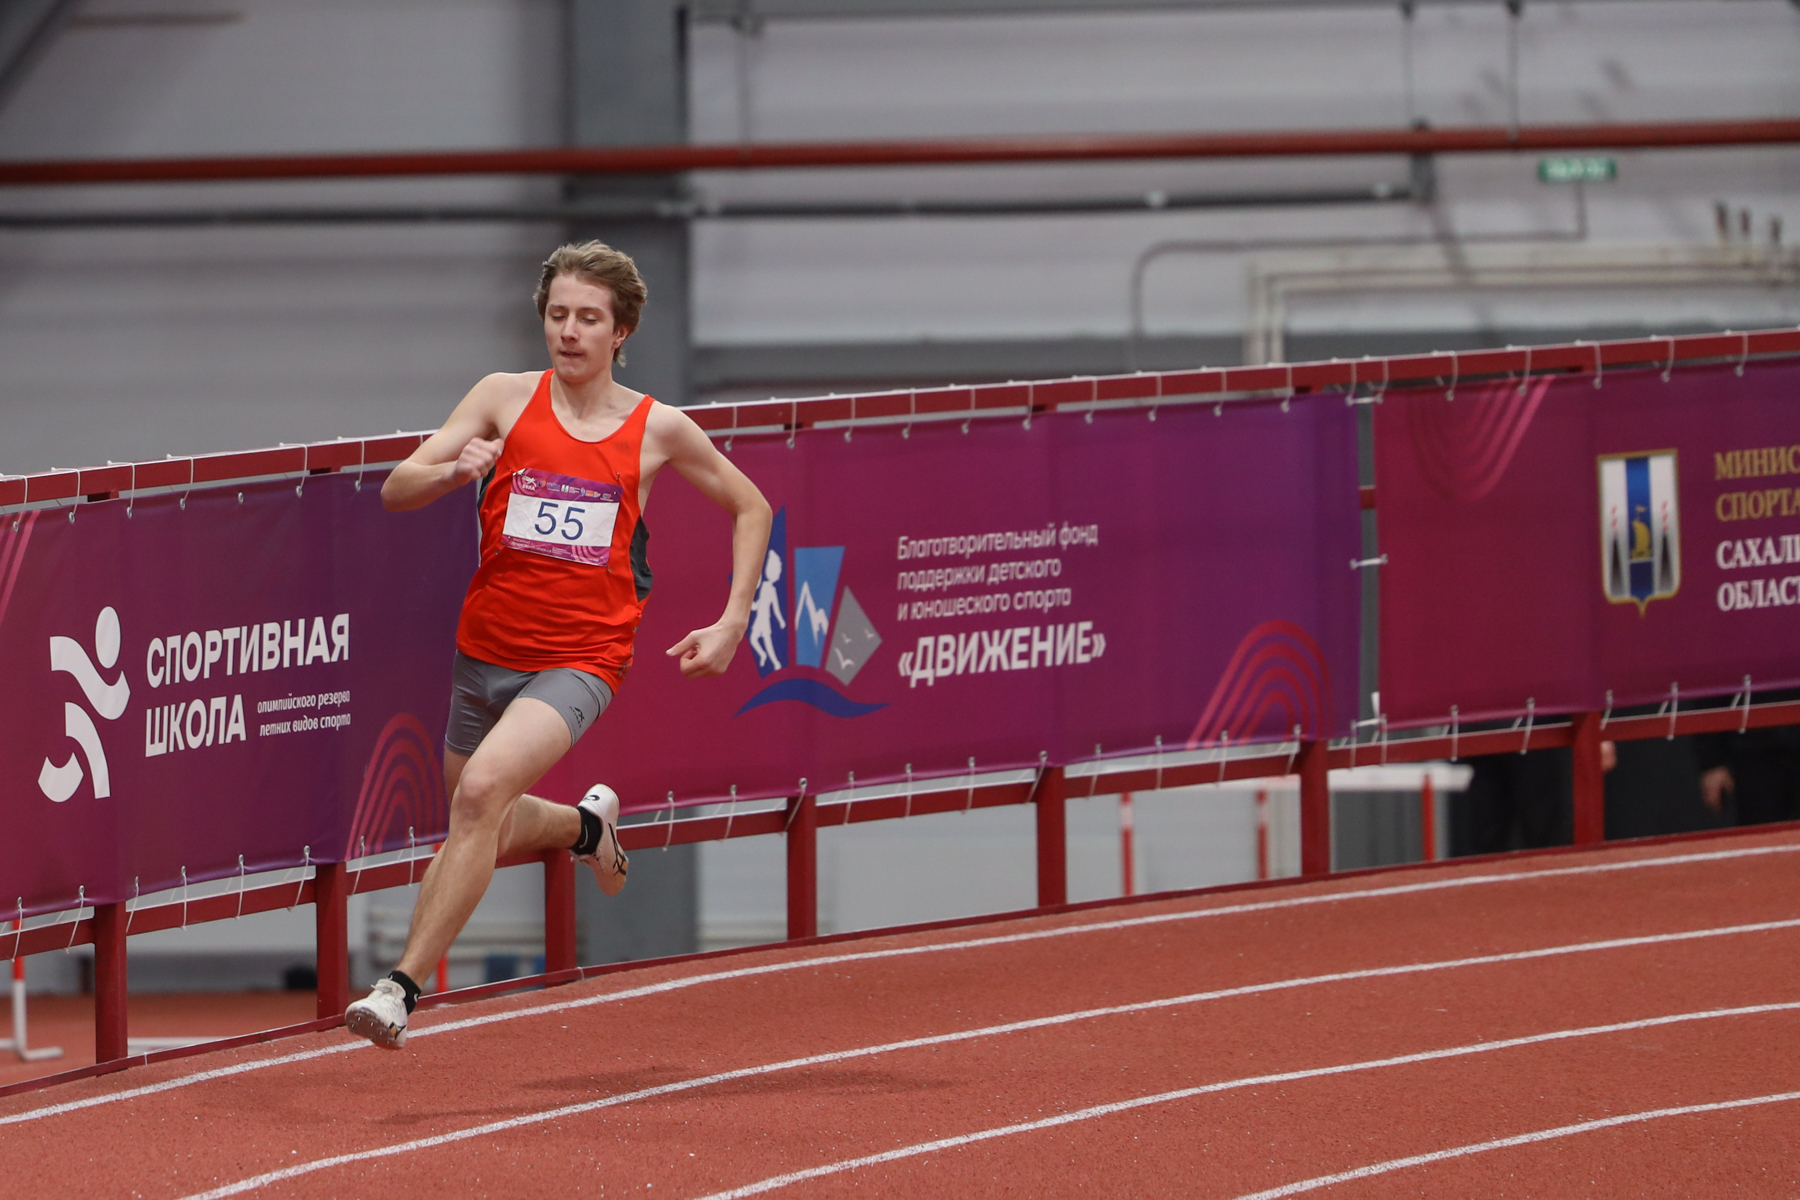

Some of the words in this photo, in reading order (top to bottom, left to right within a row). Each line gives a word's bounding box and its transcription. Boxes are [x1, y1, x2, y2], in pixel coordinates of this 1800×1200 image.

[535, 501, 586, 541] 55
[897, 523, 1056, 560] Благотворительный
[1058, 521, 1099, 550] фонд
[897, 564, 985, 591] поддержки
[987, 558, 1062, 585] детского
[897, 603, 909, 621] и
[910, 592, 1011, 620] юношеского
[1013, 587, 1072, 614] спорта
[146, 613, 350, 689] СПОРТИВНАЯ
[897, 621, 1107, 688] «ДВИЖЕНИЕ»
[257, 694, 317, 714] олимпийского
[318, 689, 351, 710] резерва
[145, 694, 247, 757] ШКОЛА
[259, 719, 292, 737] летних
[292, 715, 319, 733] видов
[320, 712, 352, 731] спорта
